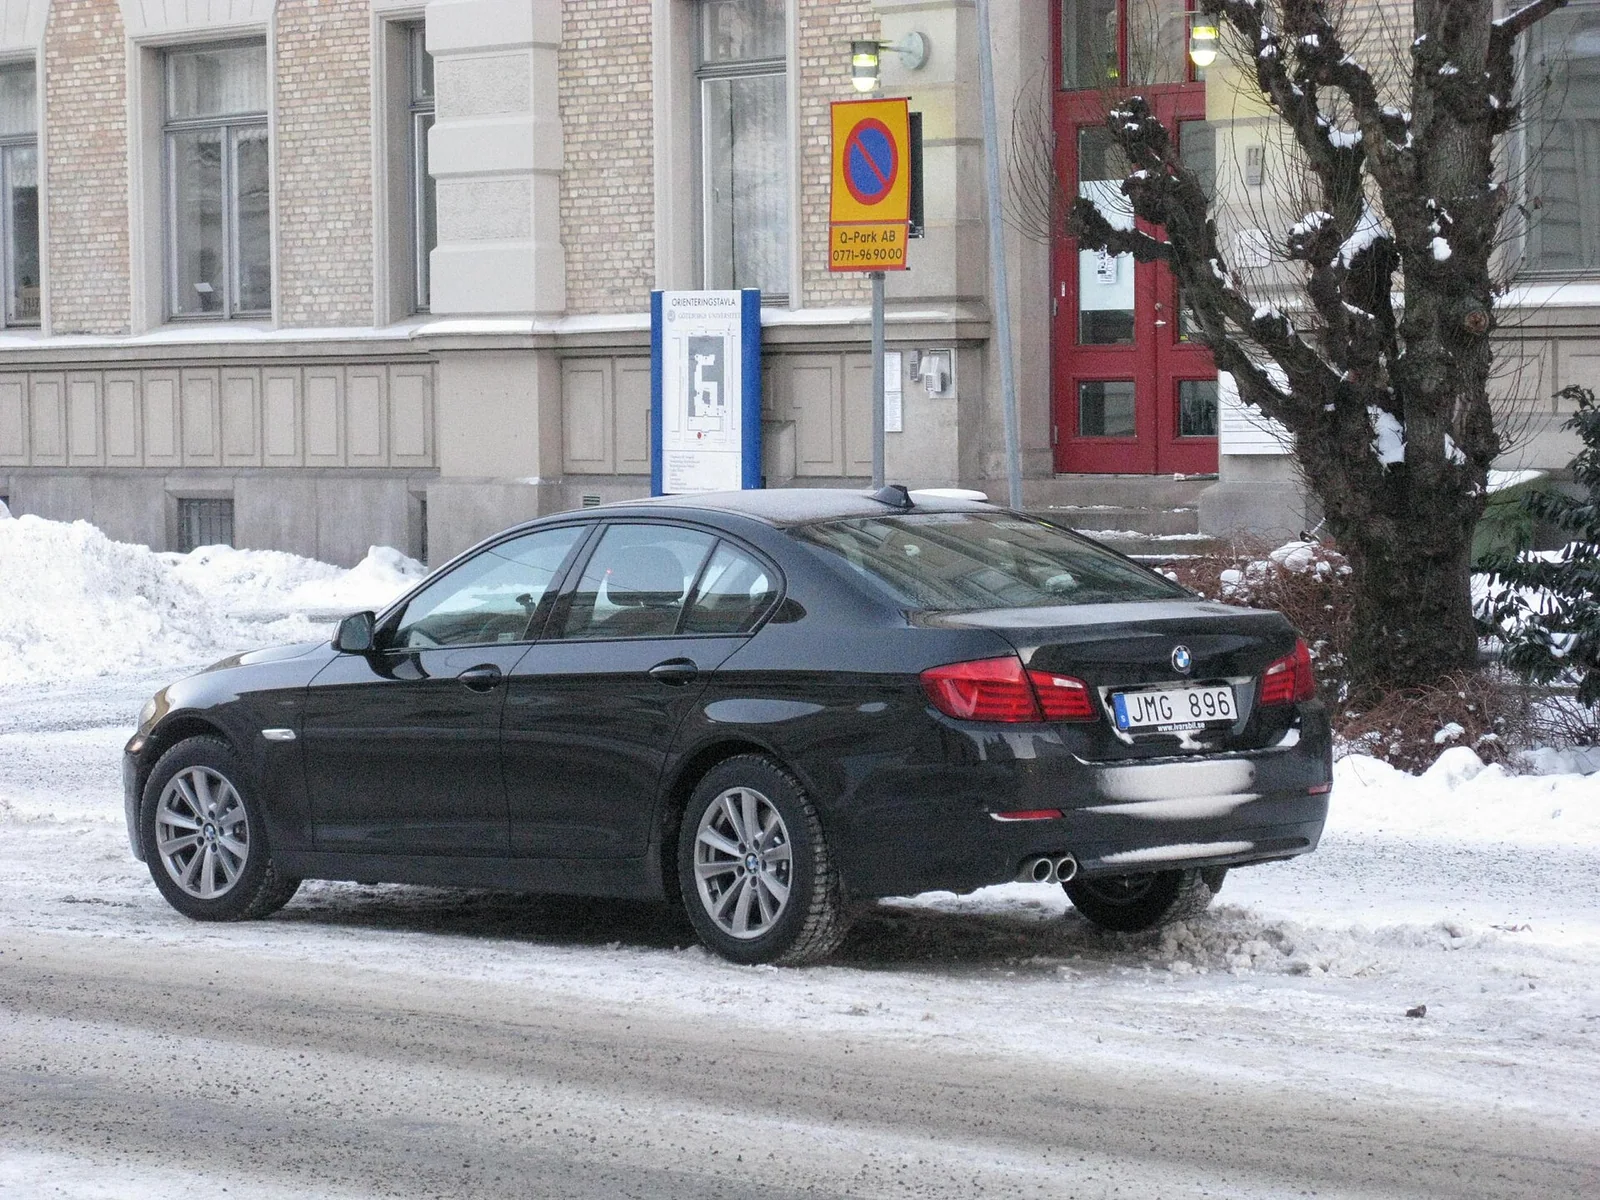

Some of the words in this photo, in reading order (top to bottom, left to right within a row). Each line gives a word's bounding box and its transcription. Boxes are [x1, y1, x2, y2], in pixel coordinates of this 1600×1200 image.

[840, 231, 877, 243] Q-Park
[881, 230, 896, 242] AB
[671, 297, 736, 306] ORIENTERINGSTAVLA
[1132, 696, 1172, 722] JMG
[1189, 691, 1230, 717] 896
